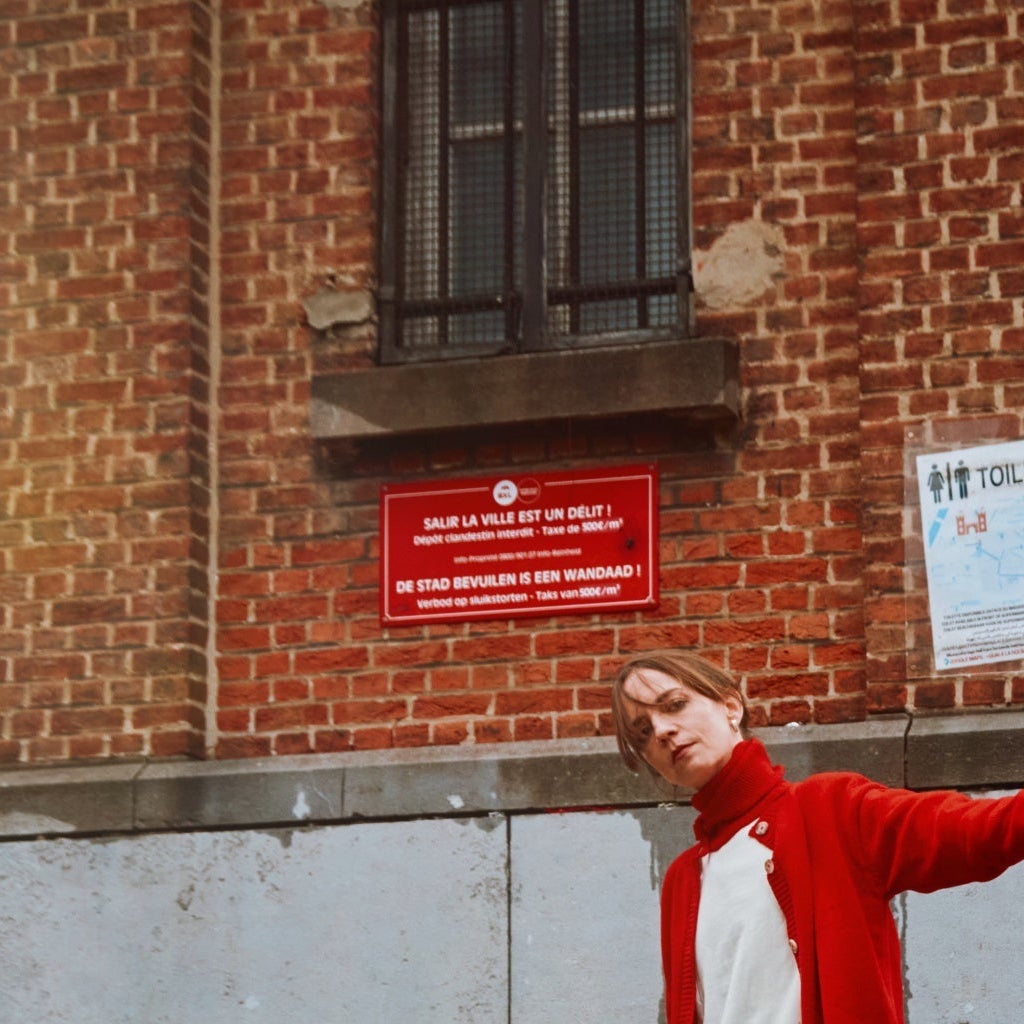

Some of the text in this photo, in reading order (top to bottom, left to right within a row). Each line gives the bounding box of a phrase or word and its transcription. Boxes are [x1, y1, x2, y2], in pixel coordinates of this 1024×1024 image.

[423, 515, 460, 531] SALIR
[462, 513, 478, 528] LA
[480, 511, 515, 526] VILLE
[518, 509, 542, 524] EST
[544, 507, 564, 521] UN
[567, 504, 604, 520] DÉLIT
[444, 529, 495, 544] clandestin
[496, 527, 534, 539] interdit
[541, 524, 566, 536] Taxe
[567, 523, 580, 534] de
[395, 580, 415, 594] DE
[416, 577, 451, 592] STAD
[453, 572, 517, 589] BEVUILEN
[519, 570, 531, 585] IS
[534, 569, 560, 584] EEN
[563, 564, 633, 582] WANDAAD
[416, 597, 453, 609] Verbod
[454, 597, 468, 607] op
[469, 592, 528, 606] sluikstorten
[535, 589, 558, 601] Taks
[559, 588, 579, 599] van
